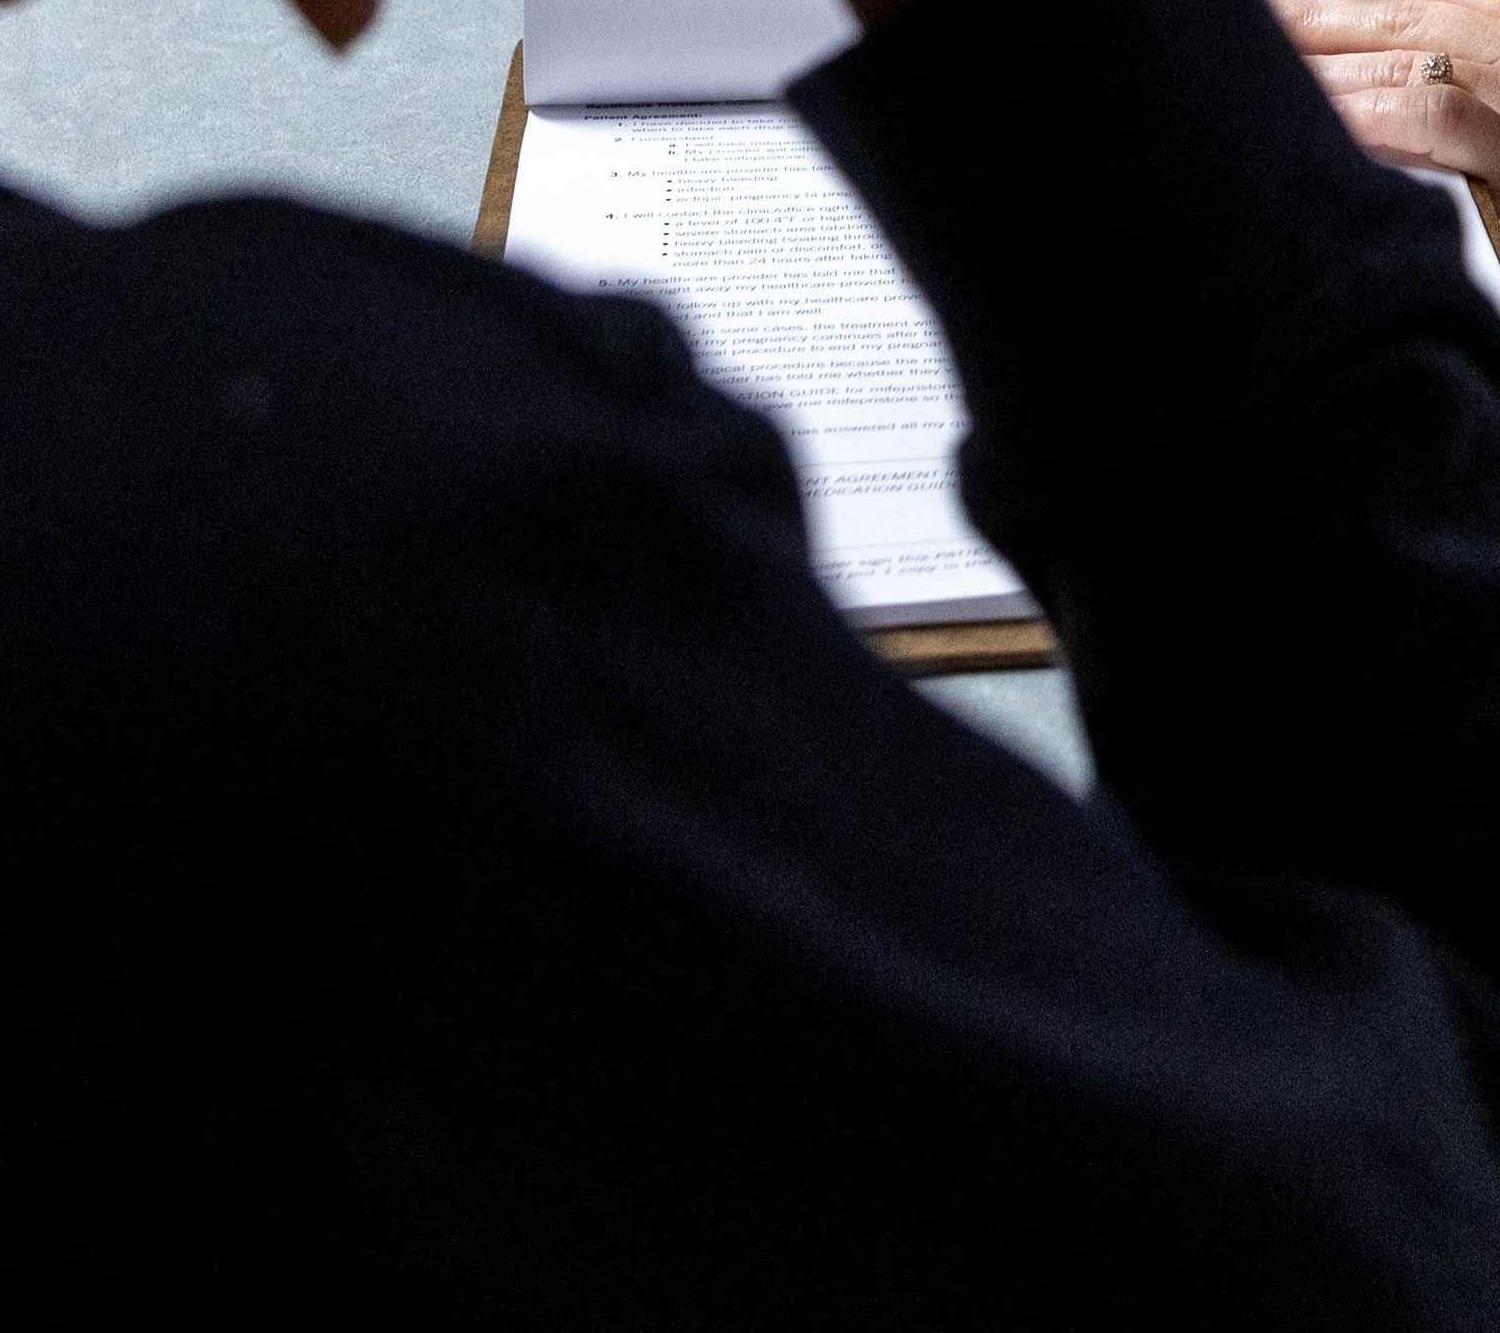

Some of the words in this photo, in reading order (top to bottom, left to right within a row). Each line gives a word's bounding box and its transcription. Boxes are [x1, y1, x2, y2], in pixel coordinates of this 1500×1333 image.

[730, 194, 801, 202] pregnancy
[738, 206, 816, 215] clinic/office
[819, 214, 862, 222] higher
[719, 238, 778, 246] bleeding
[782, 235, 840, 243] (soaking
[789, 244, 866, 253] discomfort,
[849, 253, 893, 261] taking
[615, 278, 639, 287] My
[642, 275, 718, 284] healthcare
[722, 273, 778, 281] provider
[658, 287, 691, 295] right
[761, 281, 835, 289] healthcare
[839, 279, 896, 287] provider
[804, 296, 879, 304] healthcare
[840, 321, 909, 329] treatment
[731, 336, 808, 345] pregnancy
[811, 332, 882, 341] continues
[731, 346, 806, 356] procedure
[749, 362, 825, 372] procedure
[829, 359, 891, 367] because
[754, 374, 781, 382] has
[846, 369, 903, 378] whether
[908, 368, 941, 376] they
[789, 387, 842, 396] GUIDE
[826, 395, 918, 407] mifepristone
[823, 424, 897, 433] answered
[835, 470, 938, 483] AGREEMENT
